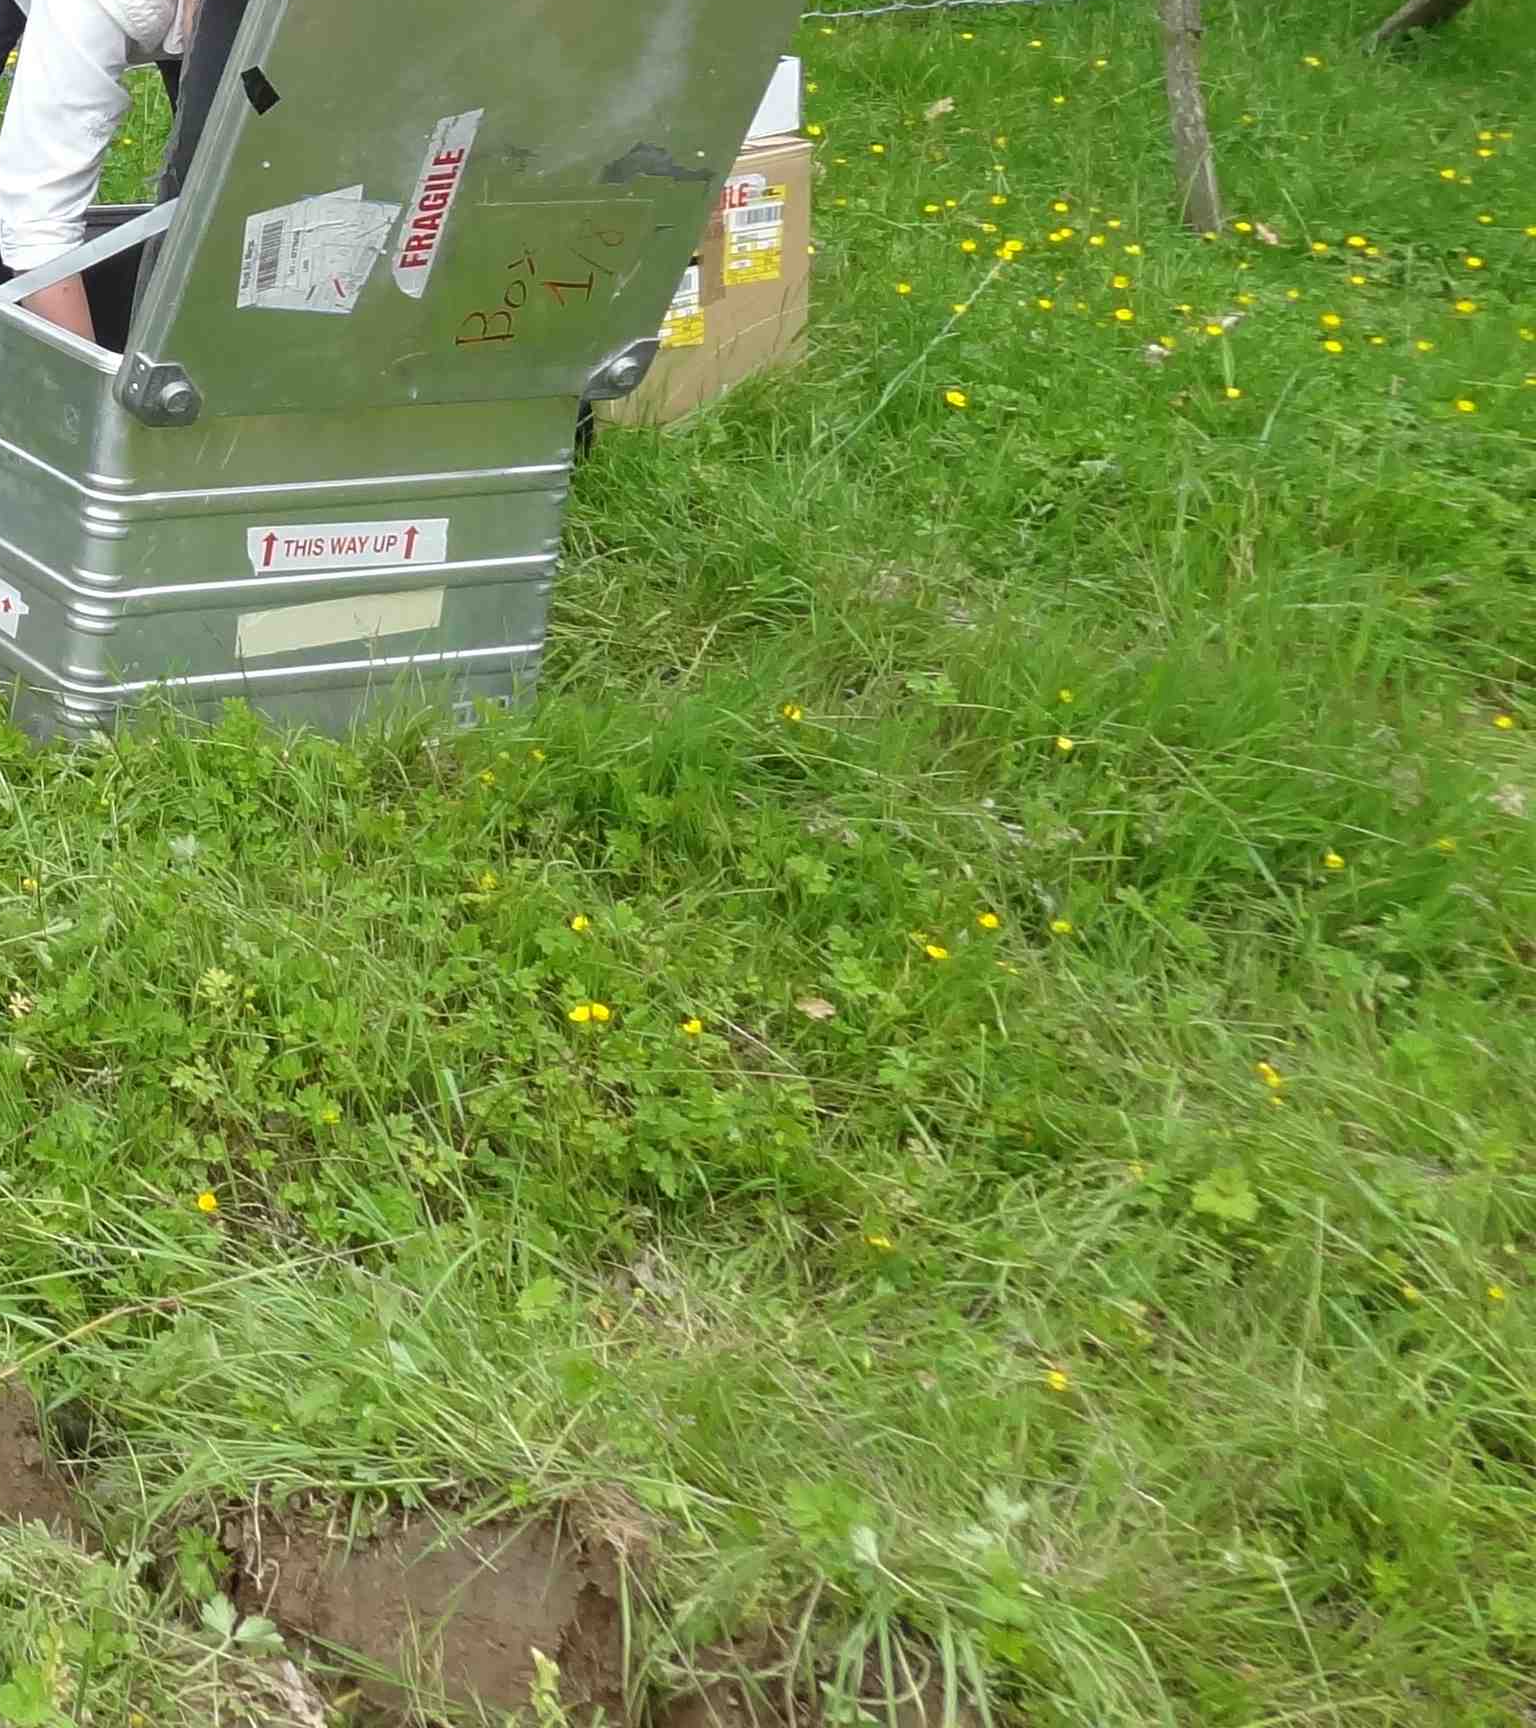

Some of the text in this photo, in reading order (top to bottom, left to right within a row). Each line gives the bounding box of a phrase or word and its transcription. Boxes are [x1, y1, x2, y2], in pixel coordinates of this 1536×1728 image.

[398, 146, 465, 271] FRAGILE
[455, 247, 537, 345] Box
[283, 535, 398, 558] THIS WAY UP
